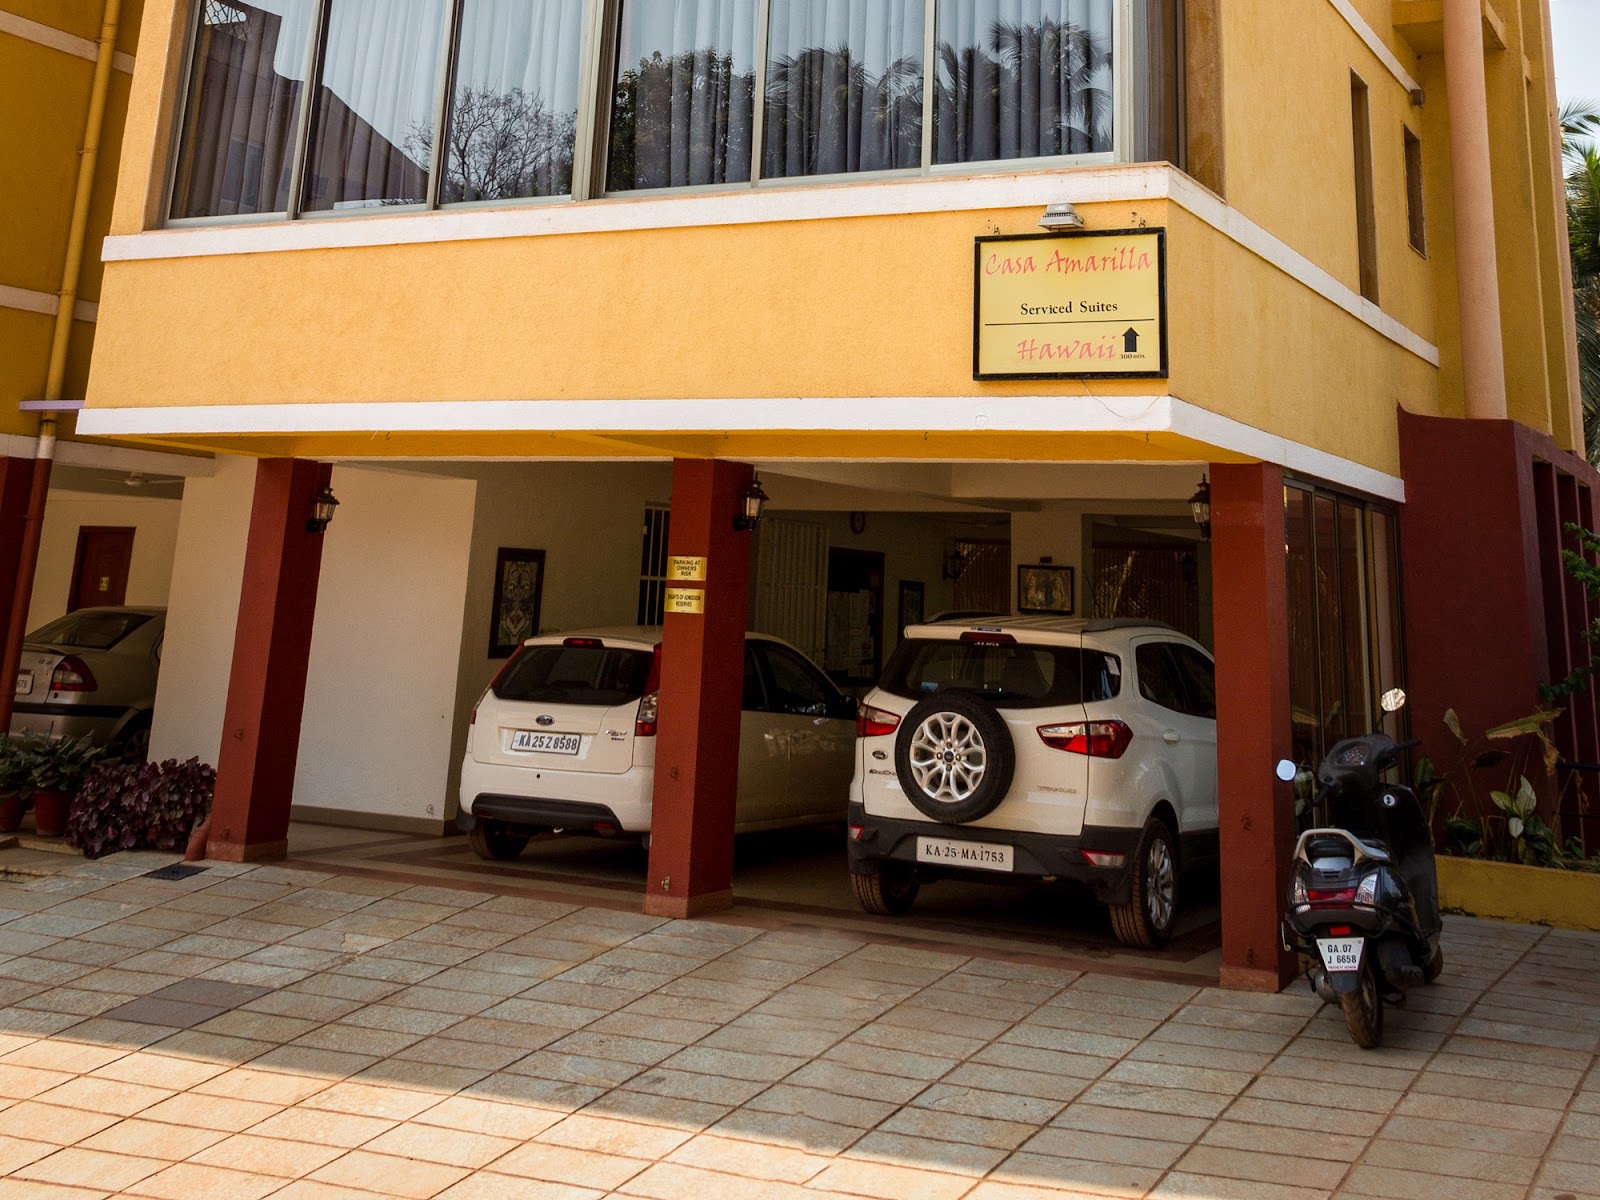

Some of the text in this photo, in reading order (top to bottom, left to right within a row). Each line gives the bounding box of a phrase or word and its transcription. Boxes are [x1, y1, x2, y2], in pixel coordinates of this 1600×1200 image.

[985, 246, 1153, 276] Casa Amarilla
[1020, 300, 1118, 316] Serviced Suites
[1016, 335, 1117, 361] Hawaii
[1328, 955, 1357, 964] J 6658
